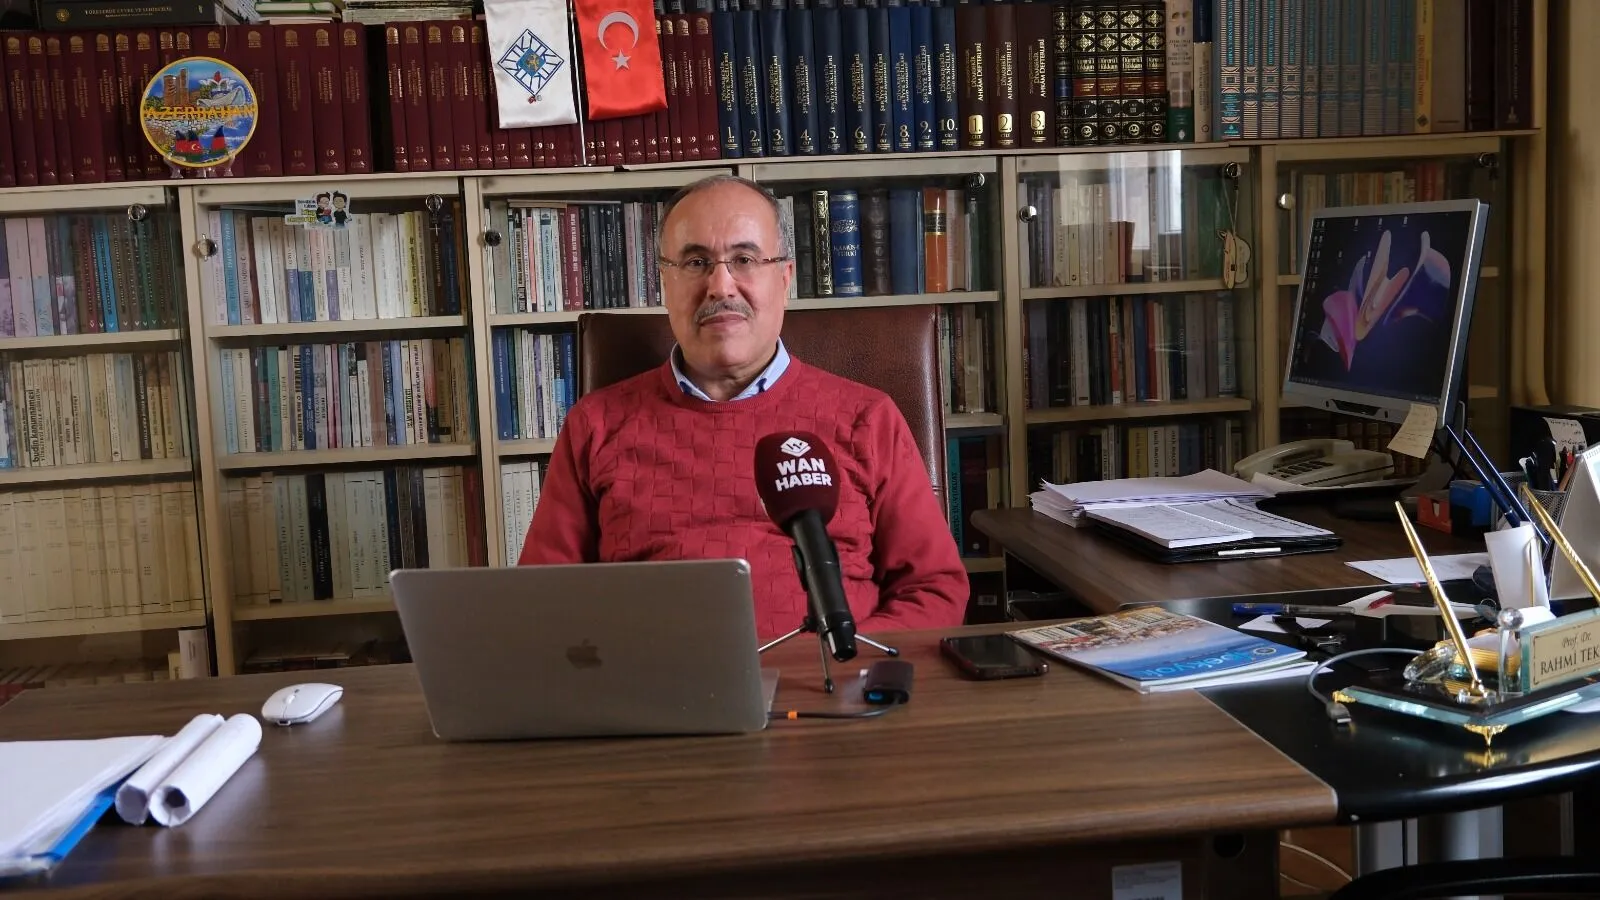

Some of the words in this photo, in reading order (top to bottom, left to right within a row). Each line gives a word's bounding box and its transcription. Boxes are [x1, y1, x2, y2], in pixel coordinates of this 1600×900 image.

[974, 42, 982, 77] DEFTERLERİ
[1004, 41, 1012, 76] DEFTERLERİ
[1037, 39, 1045, 74] DEFTERLERİ
[900, 124, 910, 138] 8.
[920, 120, 931, 133] 9.
[939, 118, 958, 131] 10.
[728, 126, 735, 139] 1.
[750, 129, 761, 142] 2.
[773, 128, 784, 142] 3.
[801, 129, 812, 141] 4.
[829, 127, 839, 139] 5.
[855, 126, 866, 139] 6.
[461, 144, 470, 152] 25
[480, 144, 489, 152] 26
[496, 143, 505, 151] 27
[516, 143, 526, 151] 28
[533, 142, 543, 150] 29
[586, 141, 595, 149] 32
[596, 140, 605, 148] 33
[326, 149, 335, 157] 19
[352, 148, 361, 156] 20
[83, 157, 91, 165] 10
[25, 389, 38, 439] kanunnamesi
[32, 440, 40, 463] budin
[776, 458, 826, 476] WAN
[775, 472, 832, 492] HABER
[1562, 633, 1579, 650] Prof.
[1541, 650, 1577, 676] RAHMİ
